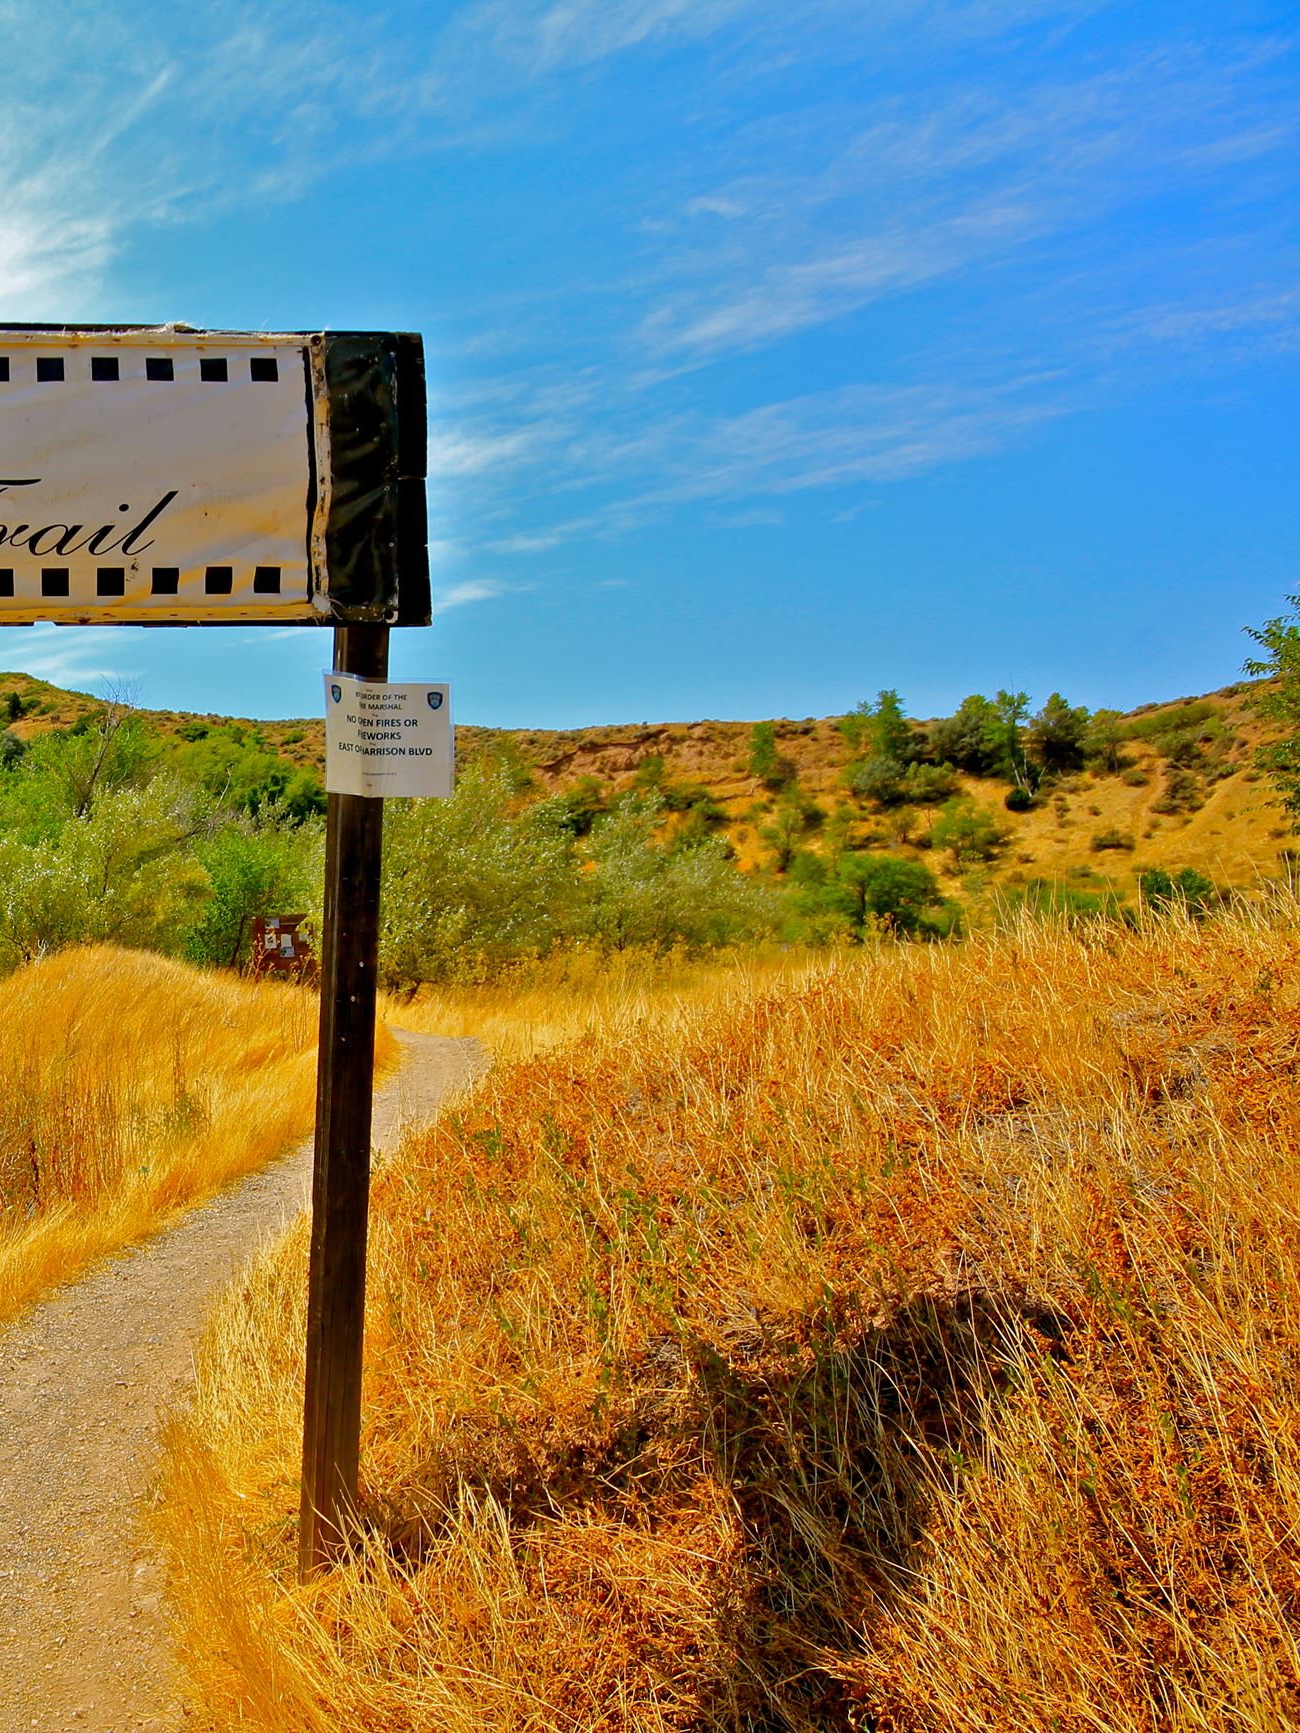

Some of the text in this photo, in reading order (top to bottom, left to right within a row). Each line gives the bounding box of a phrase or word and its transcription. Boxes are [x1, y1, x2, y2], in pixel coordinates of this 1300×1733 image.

[368, 703, 402, 711] MARSHAL
[346, 714, 357, 724] NO
[376, 719, 402, 727] FIRES
[404, 719, 418, 727] OR
[338, 742, 354, 753] EAST
[409, 747, 433, 756] BLVD
